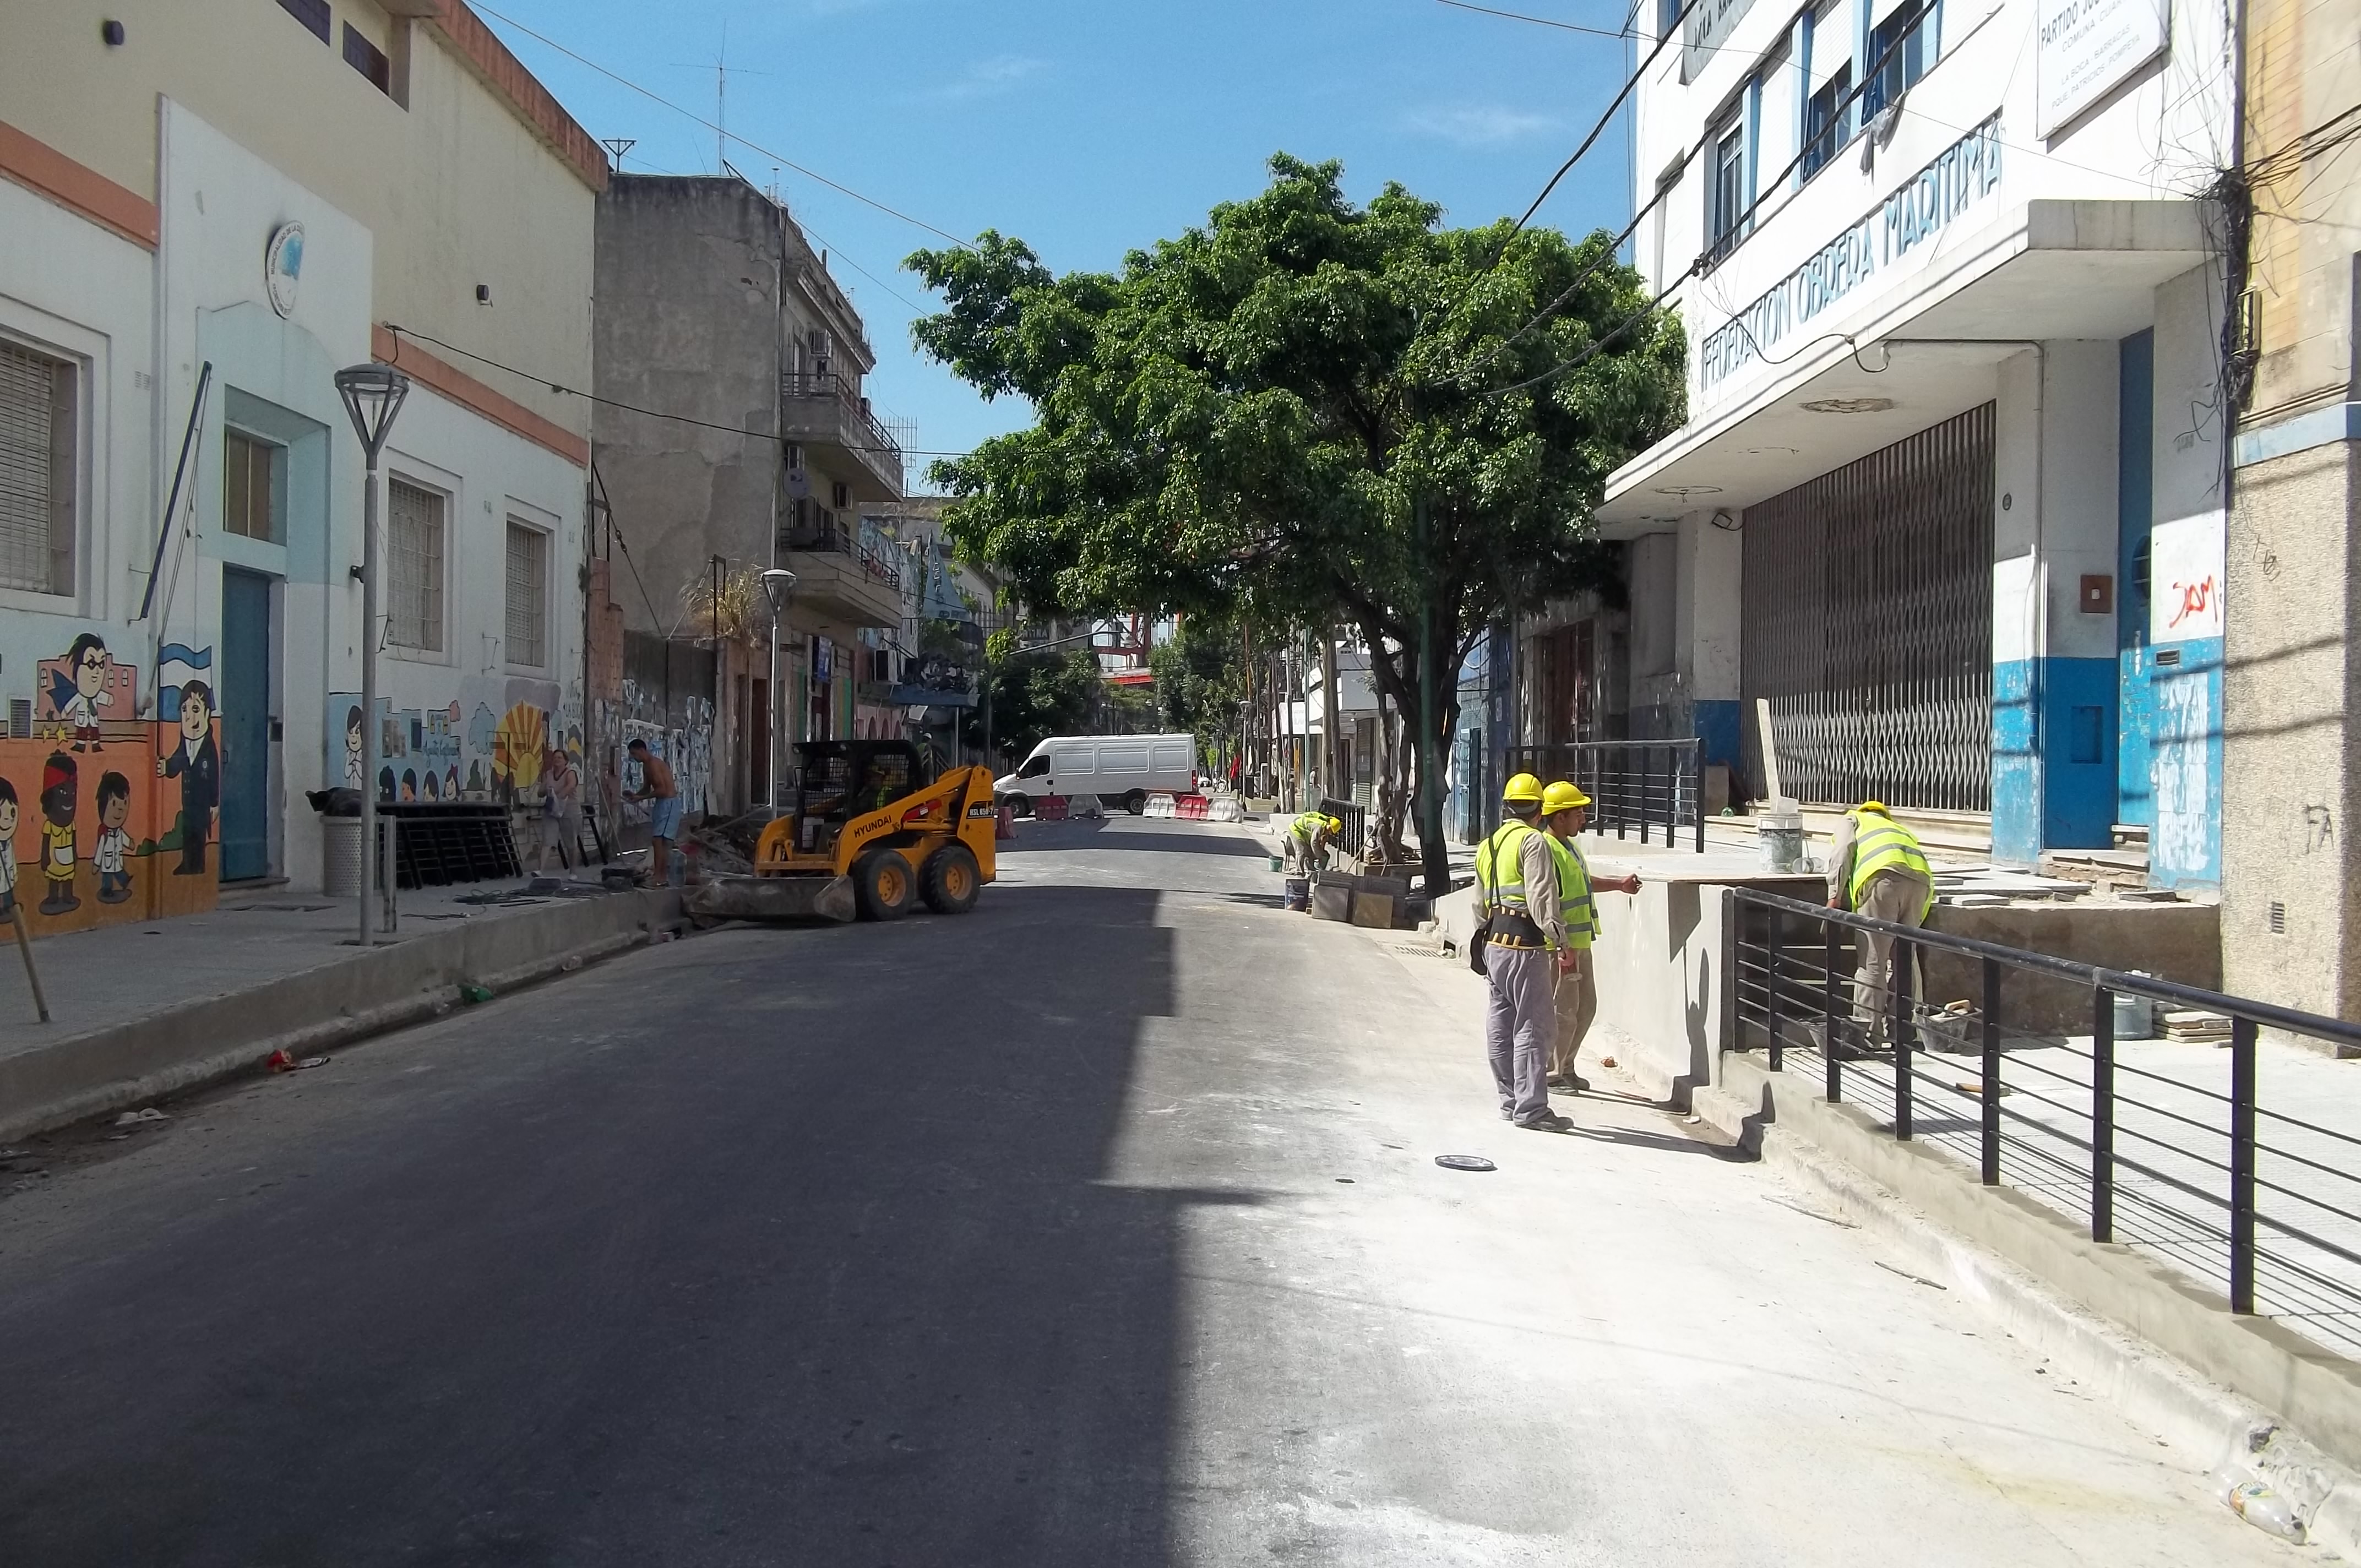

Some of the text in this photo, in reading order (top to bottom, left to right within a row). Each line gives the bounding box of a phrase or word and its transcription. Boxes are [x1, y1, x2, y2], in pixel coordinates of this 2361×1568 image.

[2041, 1, 2079, 52] PARTIDO
[2061, 24, 2130, 85] LA BOCA BARRACAS
[2062, 19, 2096, 52] COMUNA
[2071, 63, 2106, 95] PATRICIOS
[2109, 34, 2141, 67] POMPEYA
[1701, 118, 2003, 393] FEDERACION OBRERA MARITIMA
[854, 814, 892, 839] HYUNDAI
